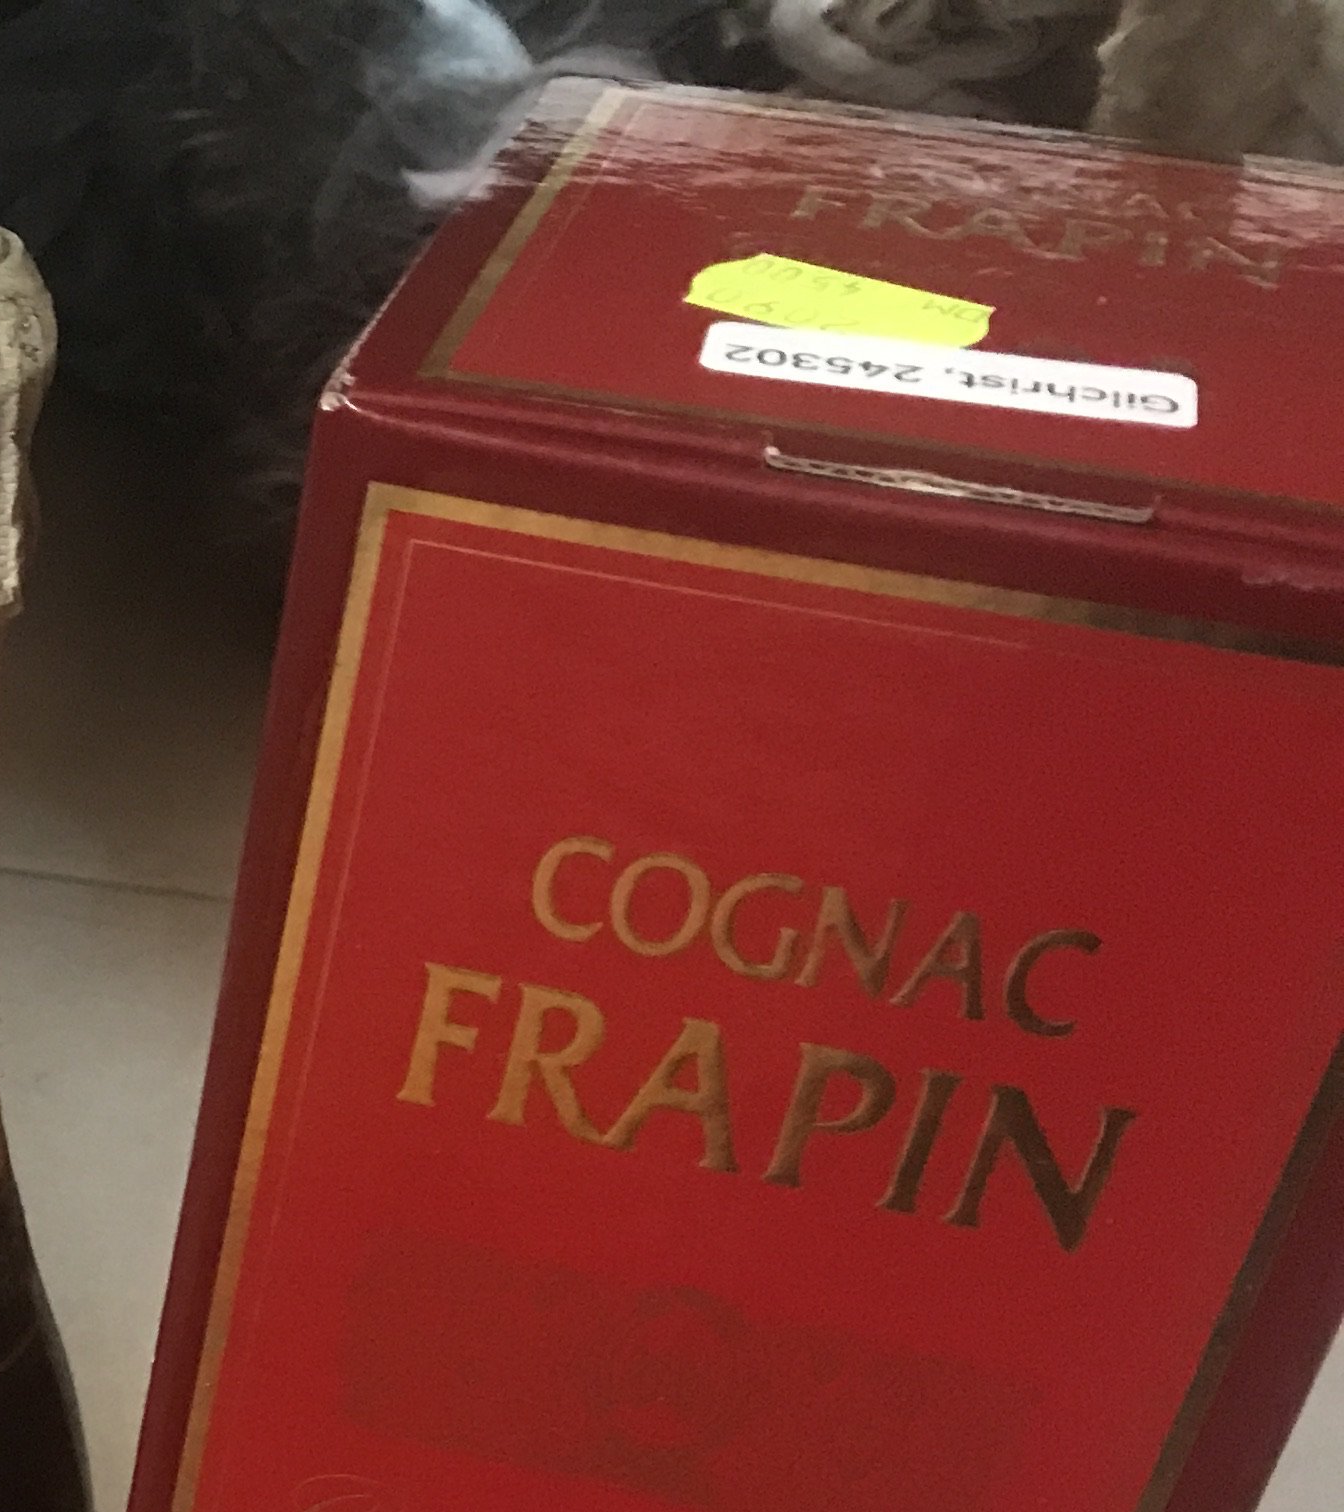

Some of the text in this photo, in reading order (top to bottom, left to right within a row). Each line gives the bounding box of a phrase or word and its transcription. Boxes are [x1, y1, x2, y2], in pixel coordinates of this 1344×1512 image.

[792, 185, 1284, 291] FRAPIN
[724, 343, 1180, 415] Gilchrist, 245302
[530, 834, 1102, 1038] COGNAC
[396, 961, 1138, 1254] FRAPIN
